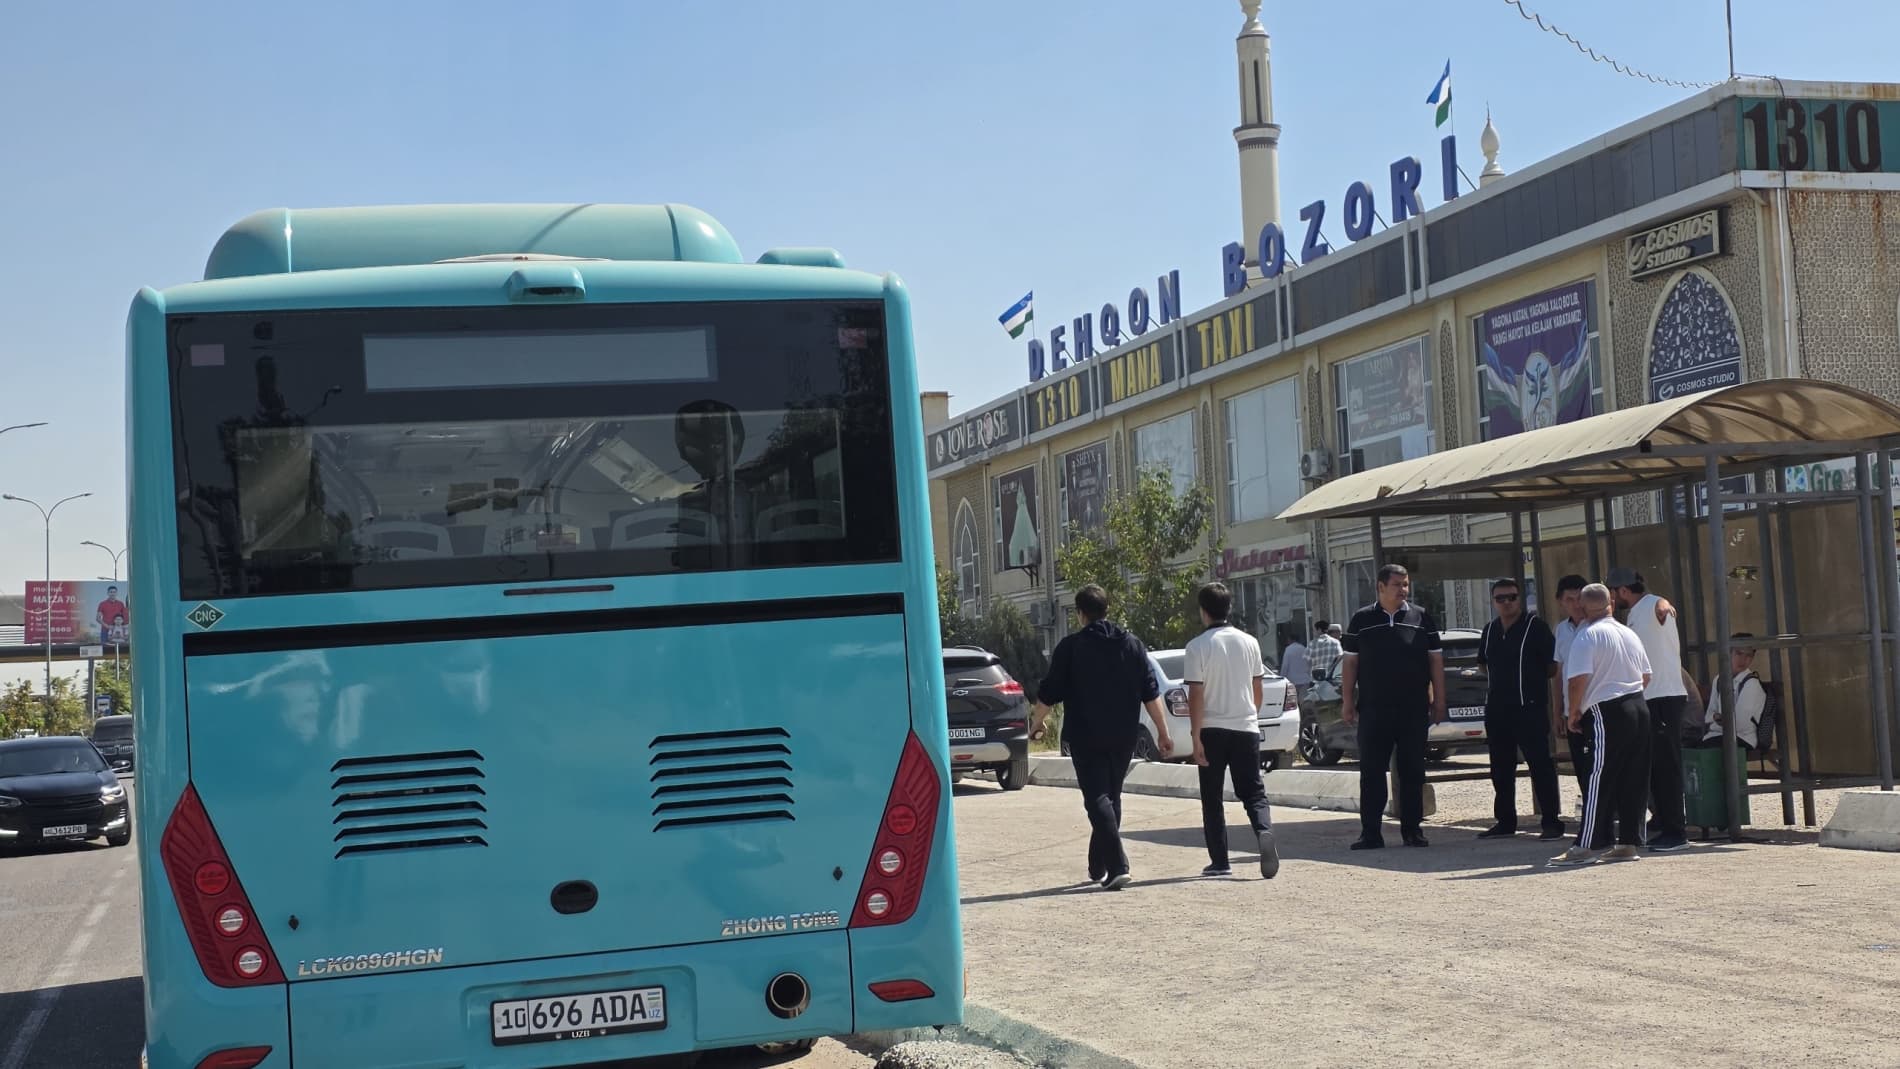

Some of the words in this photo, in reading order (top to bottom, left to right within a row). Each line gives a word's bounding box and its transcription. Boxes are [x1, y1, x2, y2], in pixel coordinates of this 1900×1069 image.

[1743, 99, 1882, 172] 1310
[1646, 214, 1713, 252] COSMOS
[1028, 269, 1182, 383] DEHQON
[1222, 135, 1459, 298] BOZORI
[1646, 245, 1692, 268] STUDIO
[1492, 312, 1512, 328] YAGONA
[1529, 303, 1549, 320] YAGONA
[1550, 297, 1562, 311] XALQ
[1492, 331, 1507, 345] YANGI
[1508, 326, 1523, 341] HAYOT
[1524, 325, 1531, 336] VA
[1532, 318, 1552, 335] KELAJAK
[1036, 376, 1081, 429] 1310
[1110, 342, 1162, 402] MANA
[1197, 303, 1256, 369] TAXI
[1676, 378, 1706, 392] COSMOS
[1707, 371, 1735, 385] STUDIO
[948, 421, 976, 460] LOVE
[976, 409, 1009, 449] ROSE
[195, 610, 216, 622] CNG
[722, 915, 787, 936] ZHONG
[790, 910, 839, 930] TONG
[298, 947, 443, 976] LCK6890HGN
[501, 1007, 526, 1030] 10
[532, 1000, 583, 1030] 696
[591, 993, 647, 1025] ADA
[649, 1008, 661, 1018] UZ
[571, 1029, 590, 1038] UZB
